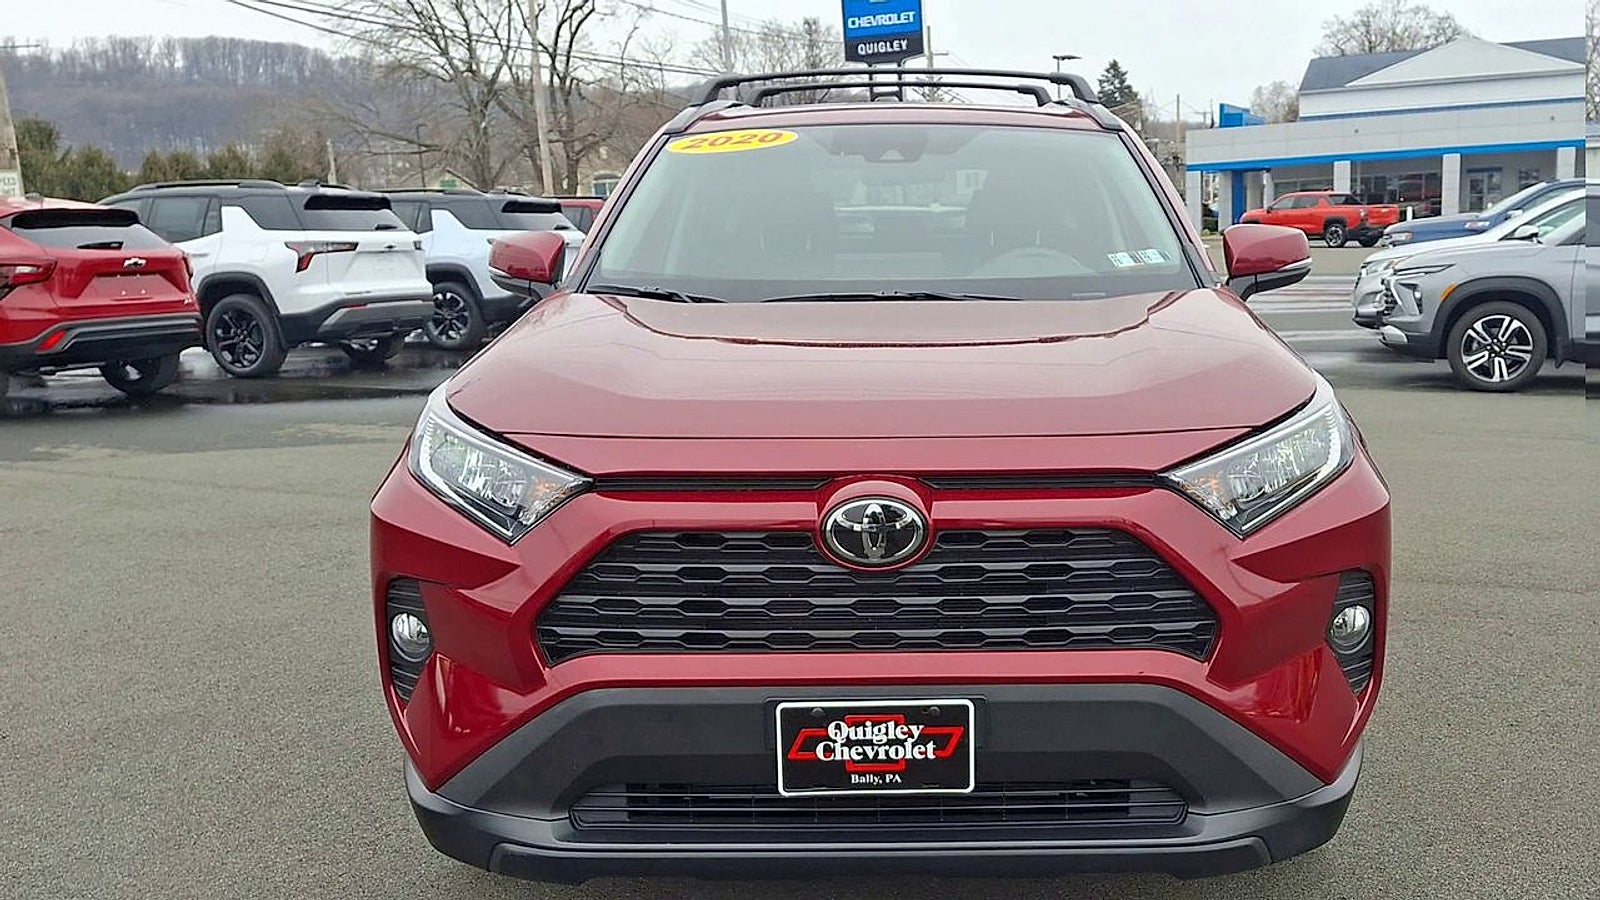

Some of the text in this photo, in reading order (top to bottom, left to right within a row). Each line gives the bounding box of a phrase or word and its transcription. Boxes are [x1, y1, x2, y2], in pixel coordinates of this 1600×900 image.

[847, 11, 916, 29] CHEVROLET
[857, 39, 908, 55] QUIGLEY
[680, 132, 783, 150] 2020
[827, 720, 925, 745] Quigley
[815, 740, 937, 761] Chevrolet
[851, 773, 902, 785] Bally, PA
